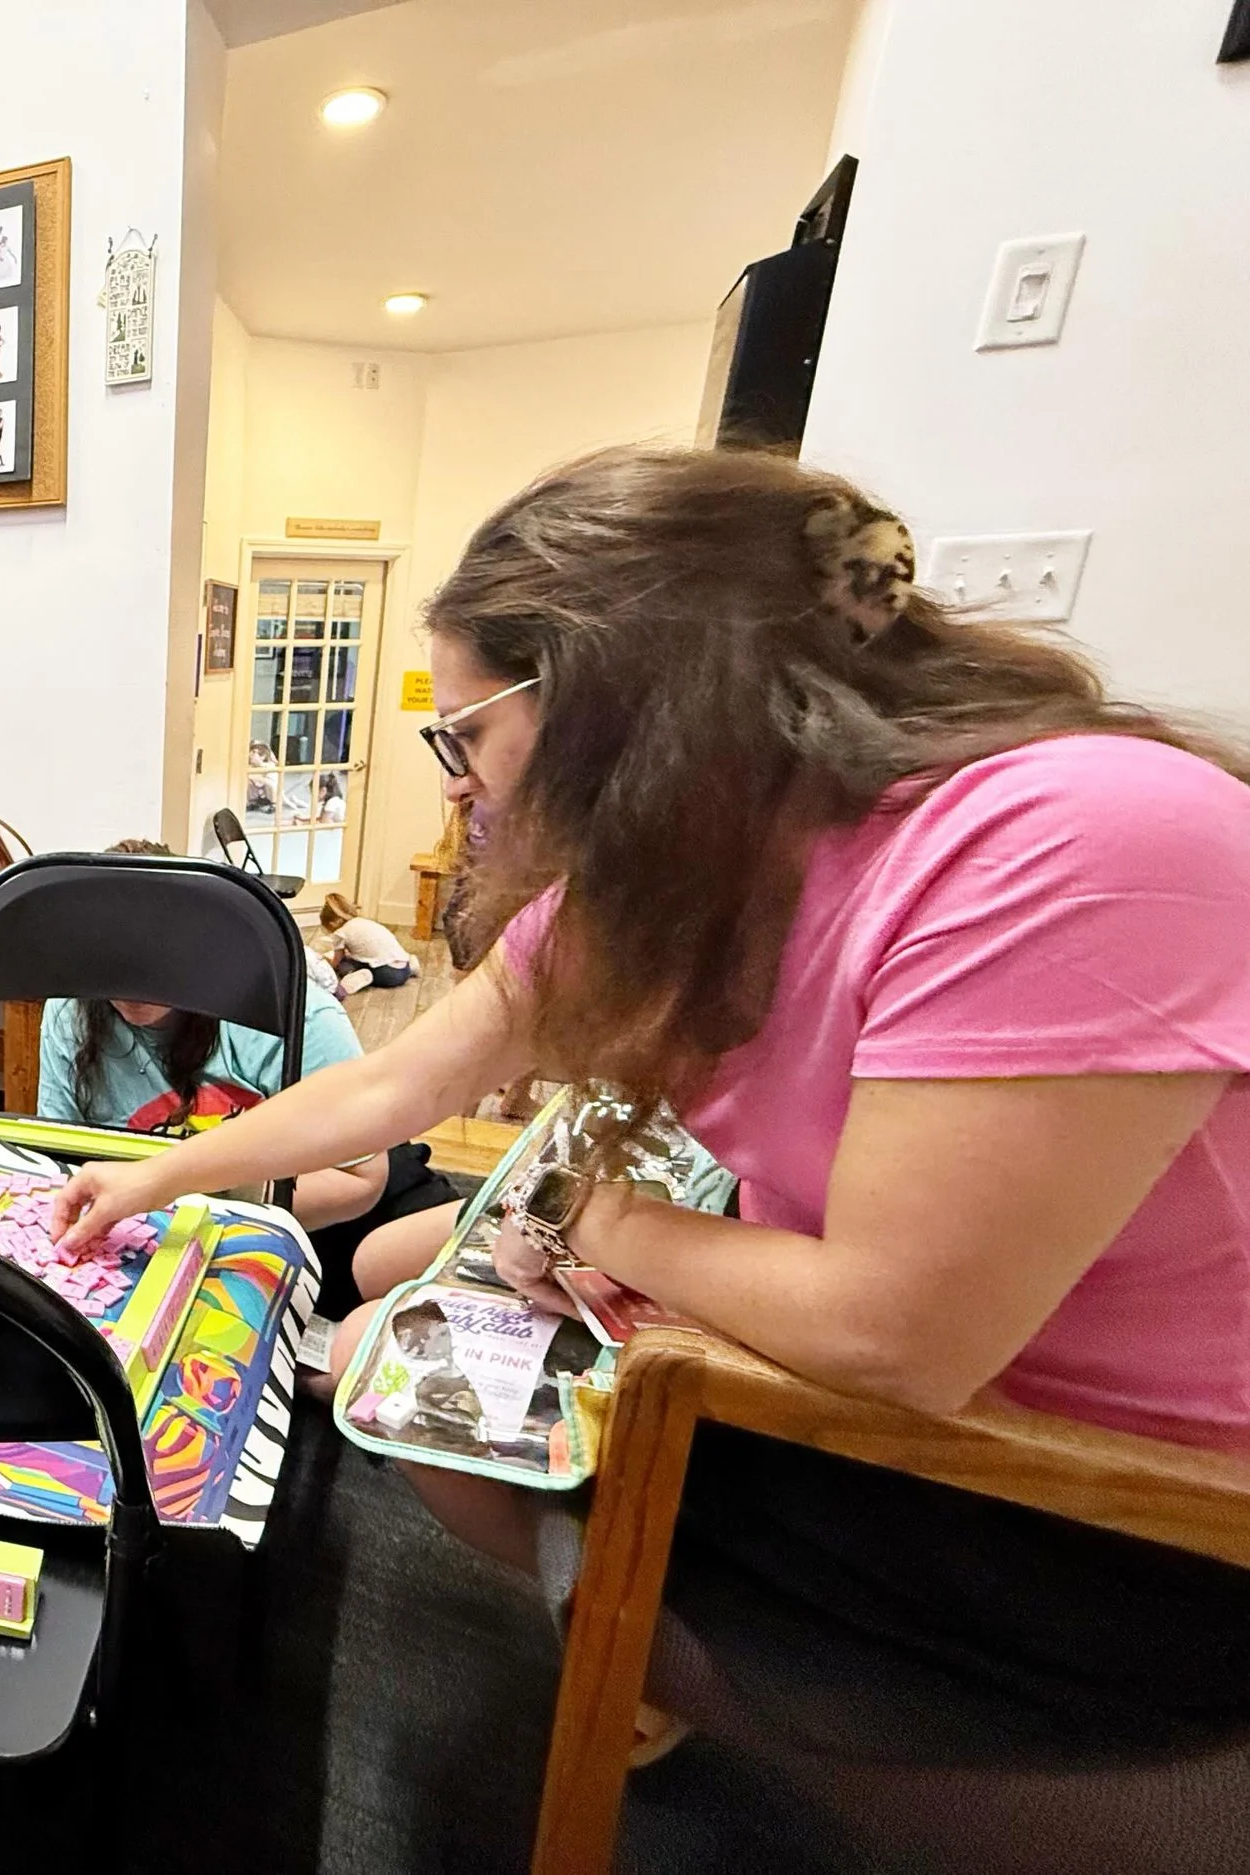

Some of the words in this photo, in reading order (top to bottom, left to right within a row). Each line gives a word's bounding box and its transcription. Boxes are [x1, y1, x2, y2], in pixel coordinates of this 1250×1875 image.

[446, 1312, 486, 1335] ahj
[481, 1319, 533, 1339] club
[464, 1347, 484, 1361] IN
[490, 1352, 533, 1372] PINK
